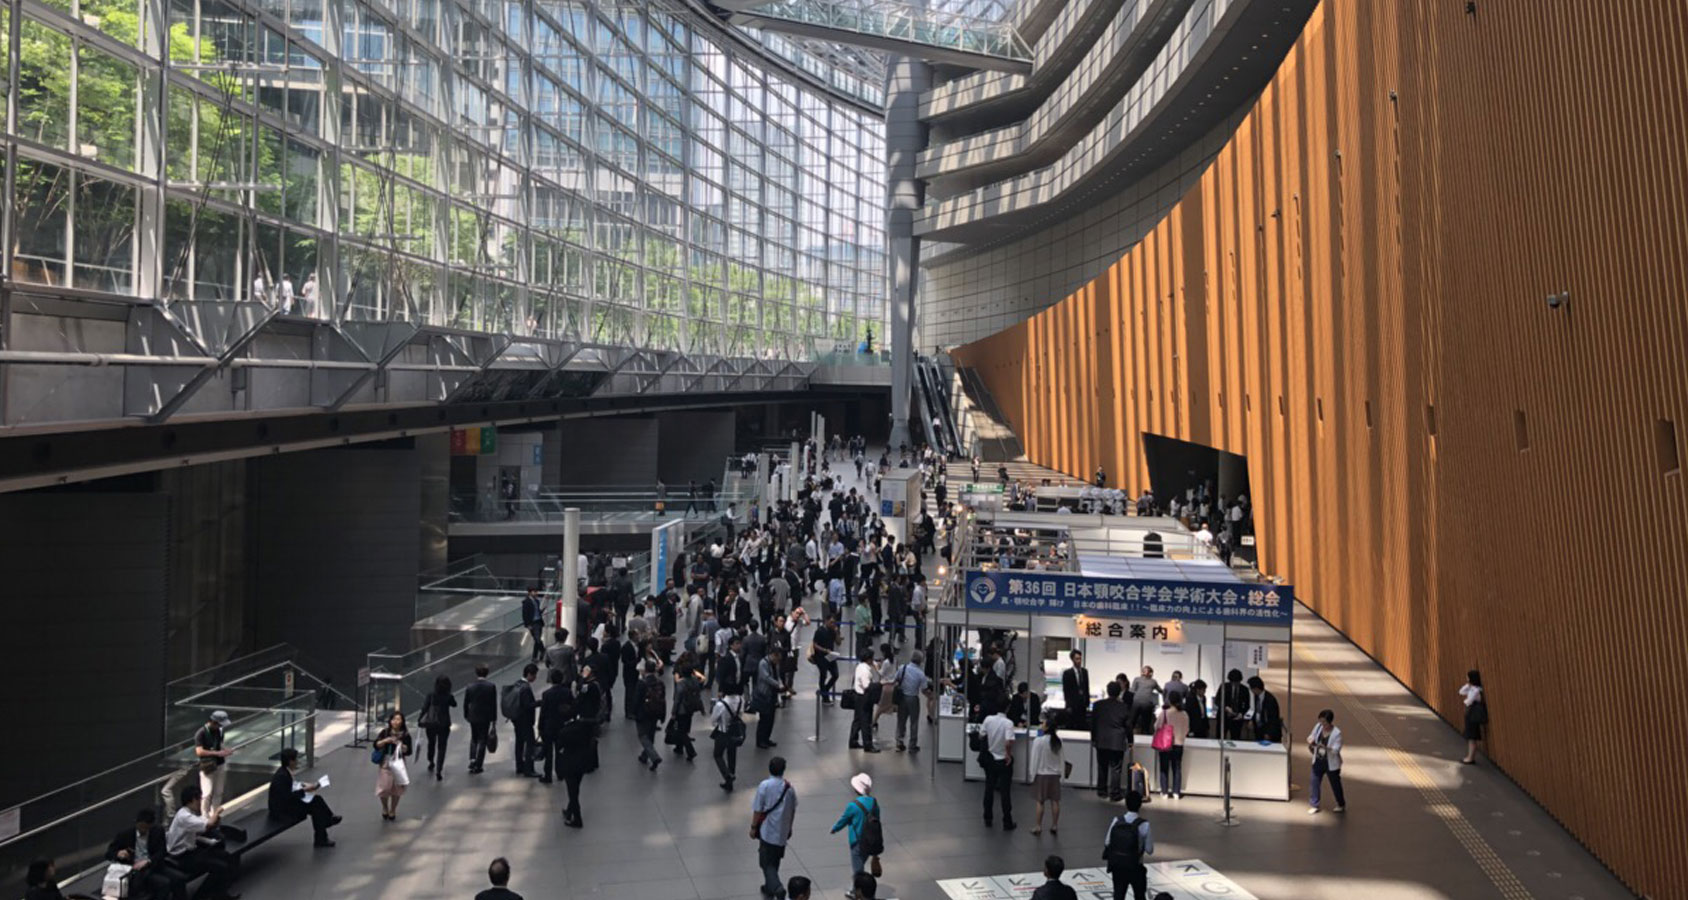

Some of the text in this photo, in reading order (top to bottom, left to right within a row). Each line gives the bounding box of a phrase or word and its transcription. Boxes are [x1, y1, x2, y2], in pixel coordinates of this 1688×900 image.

[1008, 578, 1056, 597] 第36回
[1085, 622, 1167, 640] 総合案内
